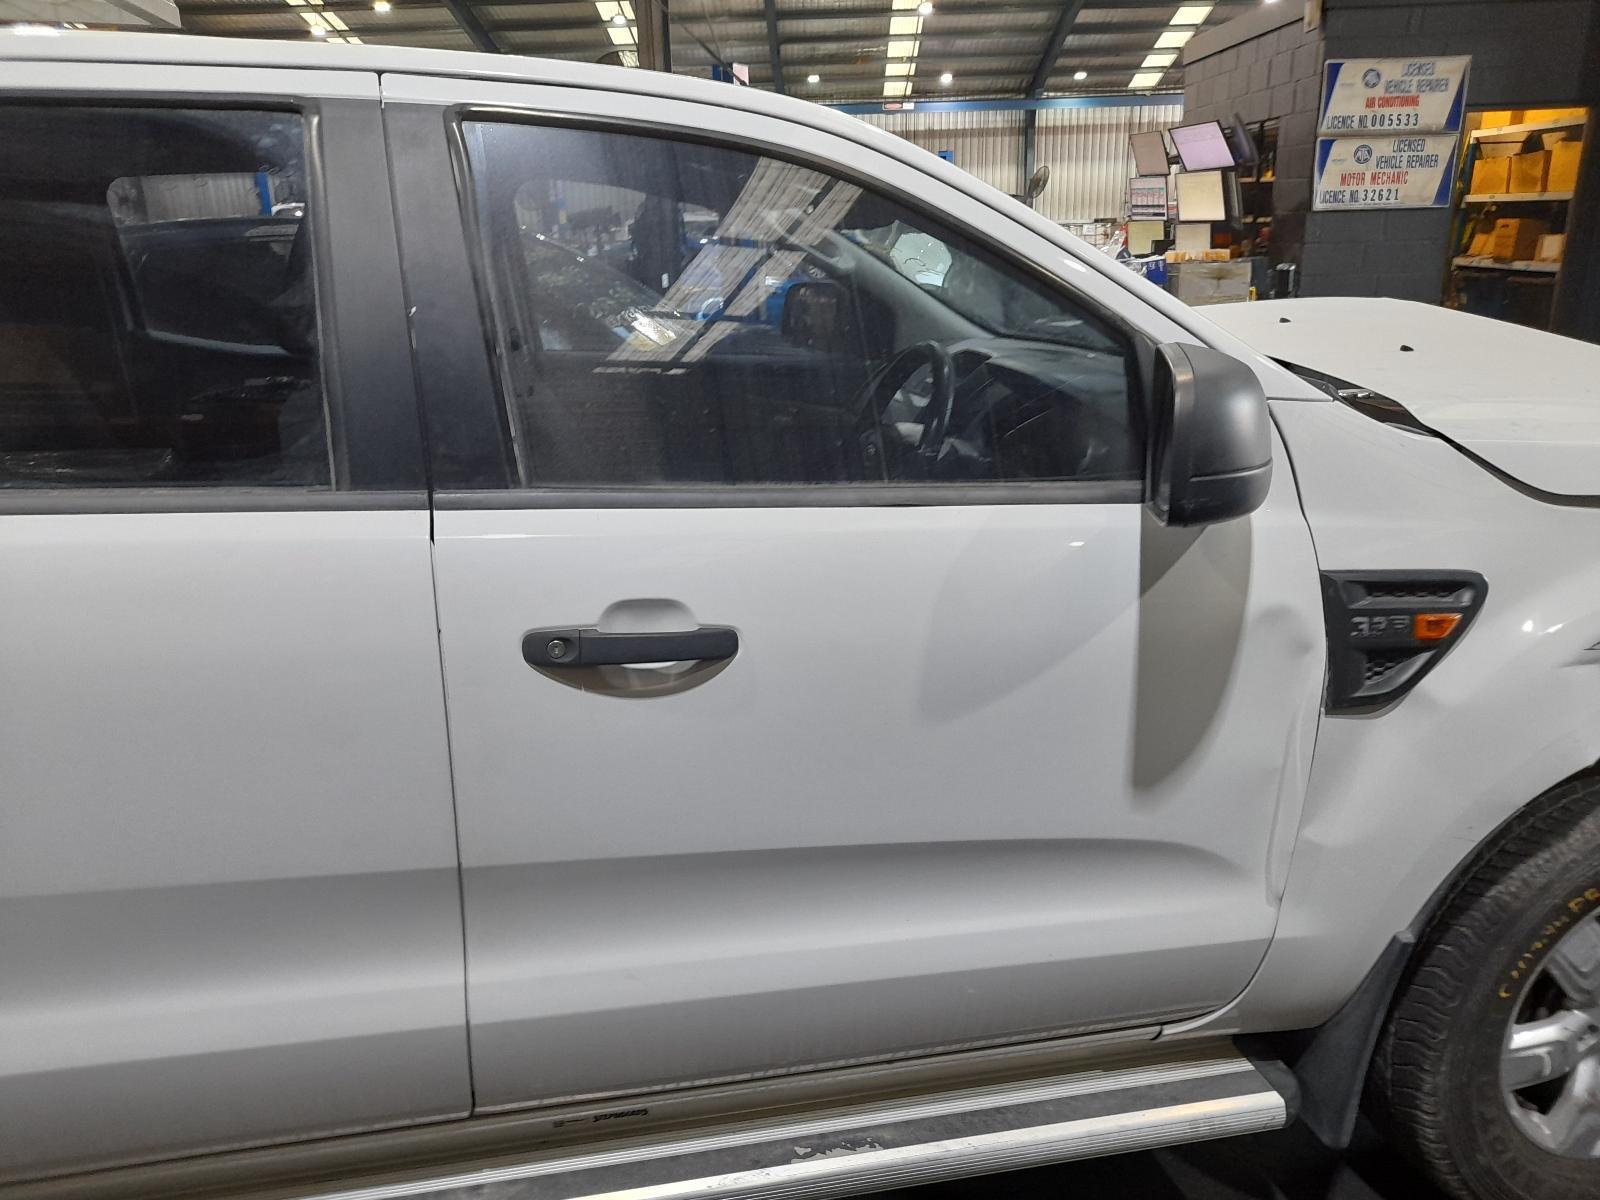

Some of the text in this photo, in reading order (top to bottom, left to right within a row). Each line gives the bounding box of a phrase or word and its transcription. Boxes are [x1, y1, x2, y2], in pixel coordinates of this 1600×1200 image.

[1365, 95, 1420, 109] AIR CONDITIONING
[1326, 115, 1355, 130] LICENCE
[1392, 139, 1426, 153] LICENSED
[1375, 154, 1439, 169] VEHICLE REPAIRER
[1340, 171, 1409, 187] MOTOR MECHANIC
[1319, 190, 1346, 204] LICENCE
